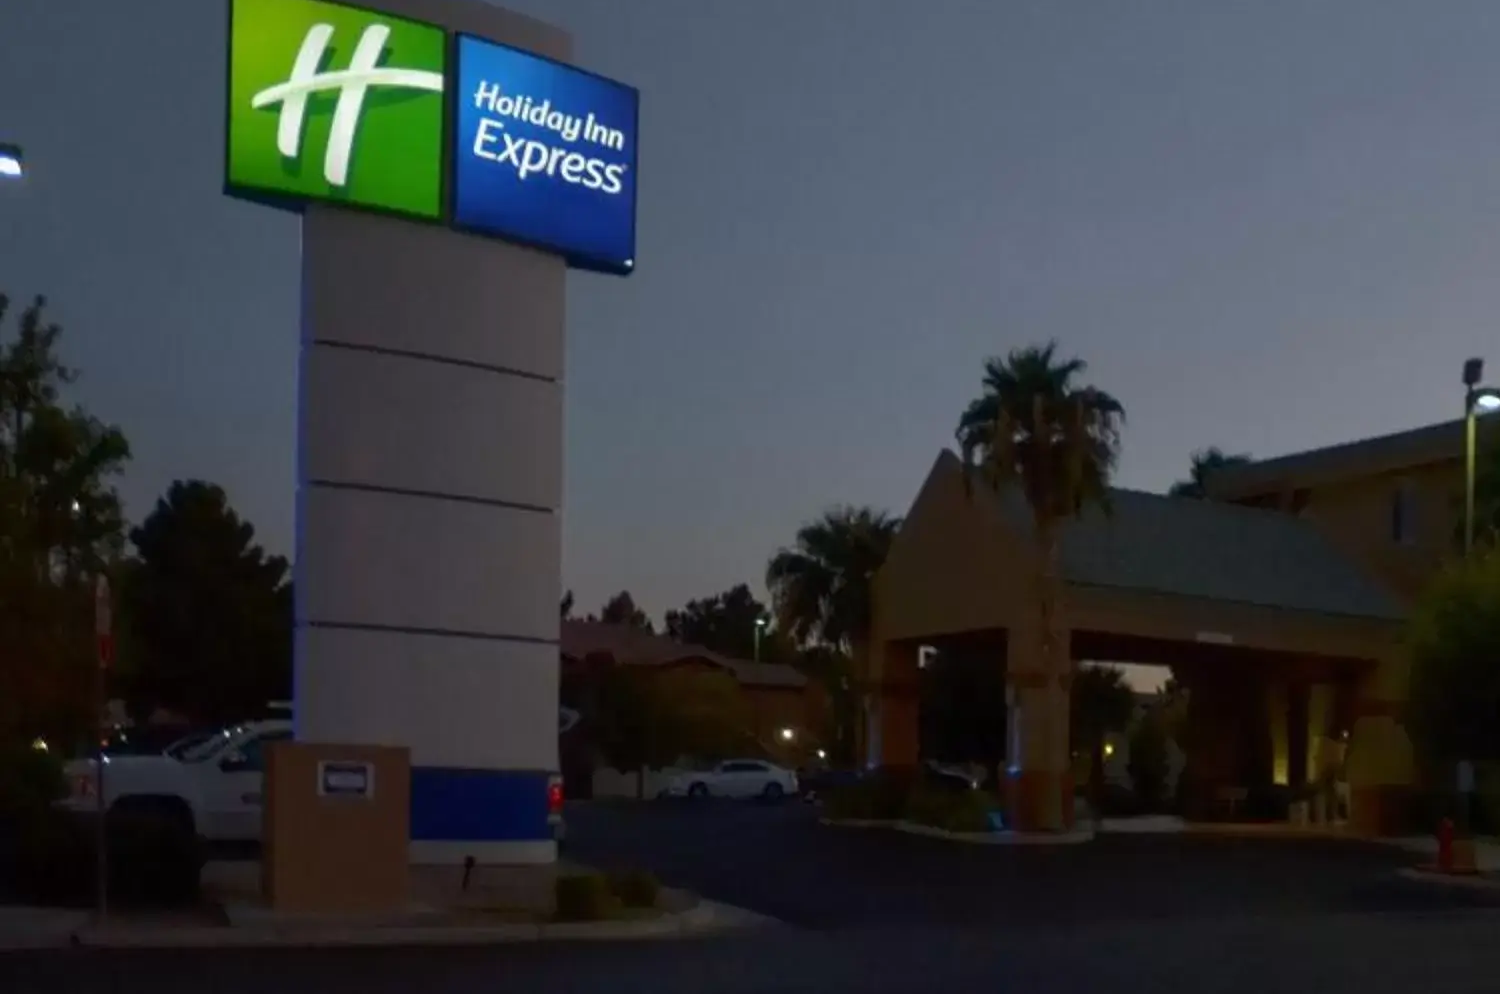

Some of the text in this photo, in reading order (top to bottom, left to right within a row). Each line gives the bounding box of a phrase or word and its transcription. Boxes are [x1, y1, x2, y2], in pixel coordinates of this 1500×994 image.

[473, 80, 625, 151] Holiday Inn
[473, 117, 623, 194] Express
